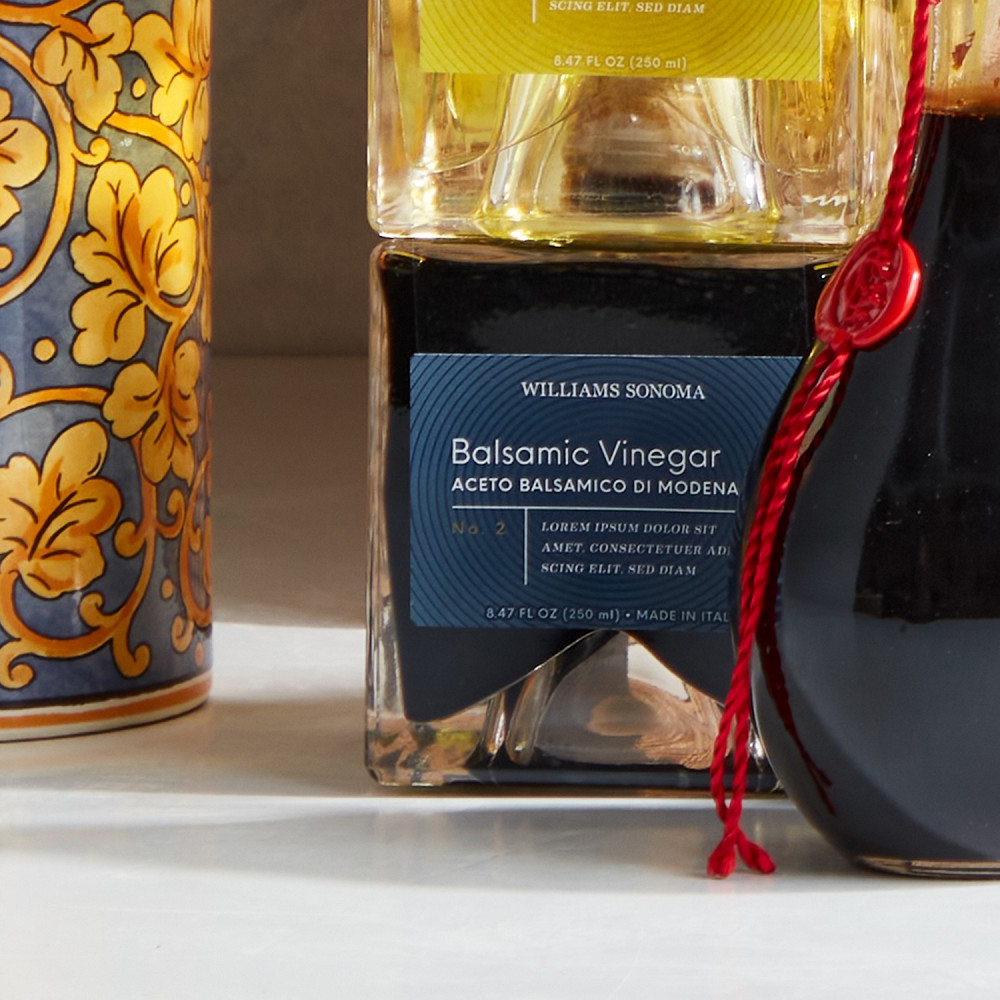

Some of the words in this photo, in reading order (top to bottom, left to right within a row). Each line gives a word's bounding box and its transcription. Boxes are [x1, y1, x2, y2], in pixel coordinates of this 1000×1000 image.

[549, 0, 593, 11] SCING
[635, 2, 663, 13] SED
[667, 3, 705, 14] DIAM
[553, 55, 582, 67] 8.47
[586, 56, 600, 67] FL
[605, 56, 625, 68] OZ
[629, 56, 661, 70] (250
[665, 56, 688, 71] ml)
[521, 381, 620, 398] WILLIAMS
[625, 383, 706, 400] SONOMA
[451, 437, 590, 467] Balsamic
[598, 440, 721, 475] Vinegar
[451, 477, 513, 492] ACETO
[519, 478, 627, 494] BALSAMICO
[633, 480, 652, 494] DI
[658, 480, 739, 496] MODENA
[495, 521, 506, 535] 2
[541, 521, 591, 533] LOREM
[594, 522, 639, 533] IPSUM
[643, 523, 690, 535] DOLOR
[693, 524, 718, 535] SIT
[589, 543, 702, 555] CONSECTETUER
[540, 563, 585, 574] SCING
[627, 564, 655, 575] SED
[659, 564, 697, 576] DIAM
[486, 607, 515, 619] 8.47
[519, 608, 534, 619] FL
[538, 608, 558, 620] OZ
[562, 608, 594, 622] (250
[598, 608, 620, 623] ml)
[636, 609, 676, 621] MADE
[681, 610, 696, 621] IN
[701, 611, 729, 623] ITAL
